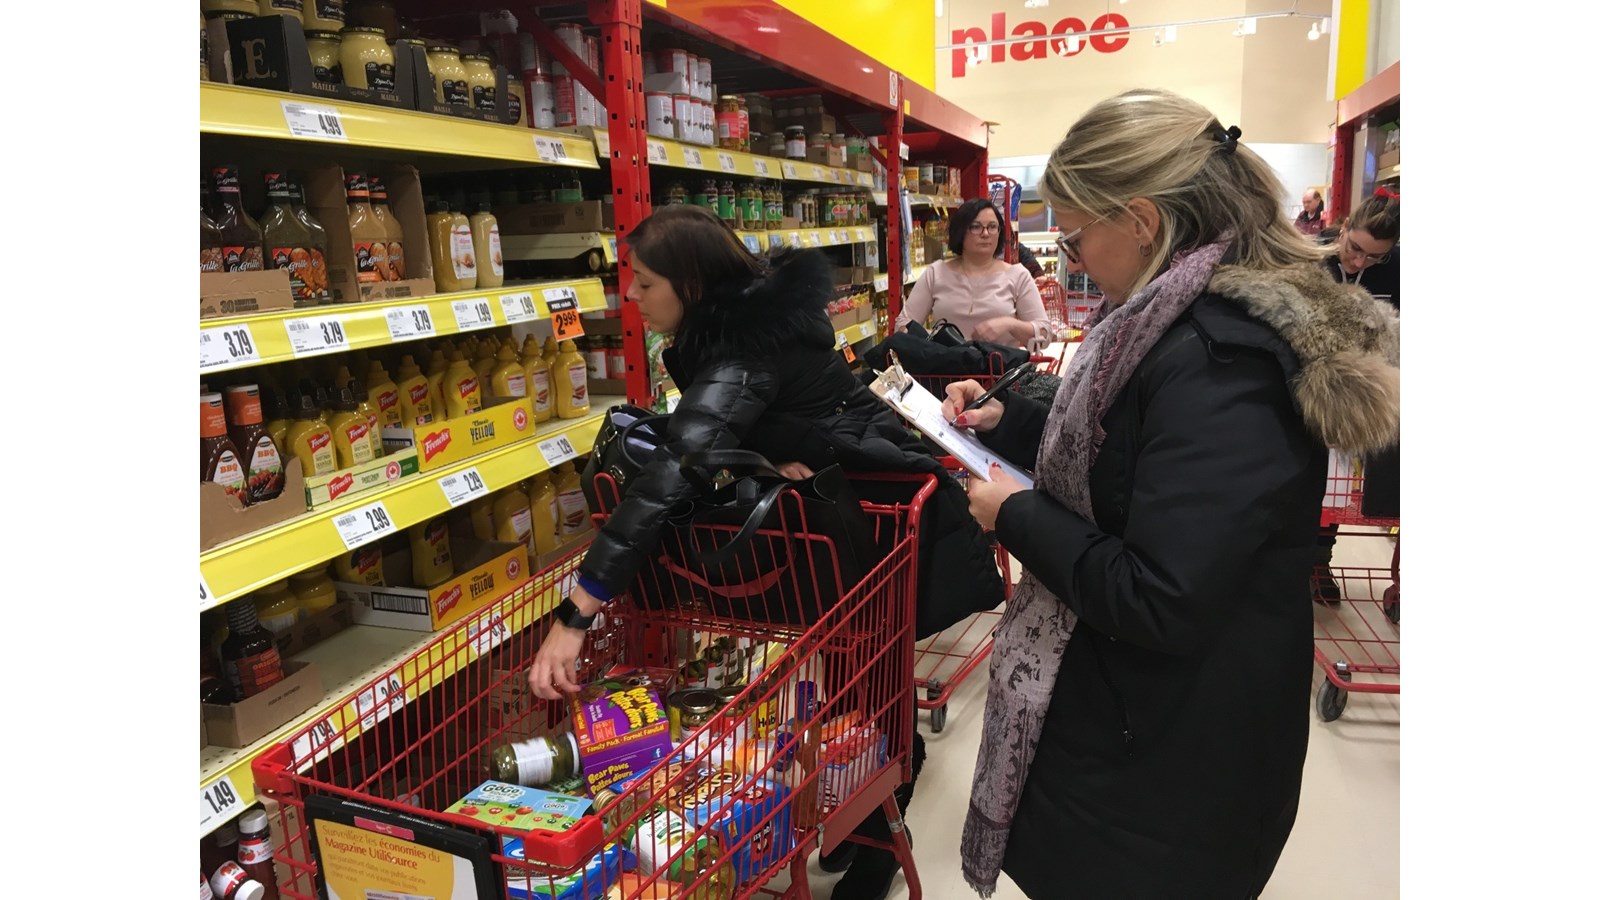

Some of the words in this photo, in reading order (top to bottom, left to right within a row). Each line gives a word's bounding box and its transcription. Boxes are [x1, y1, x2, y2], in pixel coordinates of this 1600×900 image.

[952, 12, 1130, 78] place
[318, 113, 342, 136] 4.99
[474, 302, 492, 323] 1.99
[520, 296, 535, 315] 1.99
[411, 309, 431, 332] 3.79
[223, 329, 253, 358] 3.79
[320, 321, 344, 345] 3.79
[424, 430, 449, 455] French's
[470, 422, 495, 441] YELLOW
[257, 449, 275, 458] BBQ
[556, 438, 573, 455] 1.29
[220, 464, 238, 474] BBQ
[331, 474, 353, 494] French's
[463, 471, 484, 492] 2.29
[365, 506, 390, 532] 2.99
[470, 573, 494, 598] YELLOW
[437, 587, 460, 612] French's
[587, 743, 605, 753] Family
[606, 737, 620, 748] Pack
[623, 732, 643, 742] Format
[644, 724, 665, 736] Familial
[588, 768, 608, 784] Bear
[608, 762, 629, 773] Paws
[204, 780, 236, 814] 1.49
[590, 779, 613, 795] Pattes
[322, 825, 363, 843] Surveillez
[365, 835, 378, 847] les
[379, 838, 426, 860] économies
[428, 850, 440, 863] du
[325, 837, 367, 853] Magazine
[368, 847, 418, 870] UtiliSource
